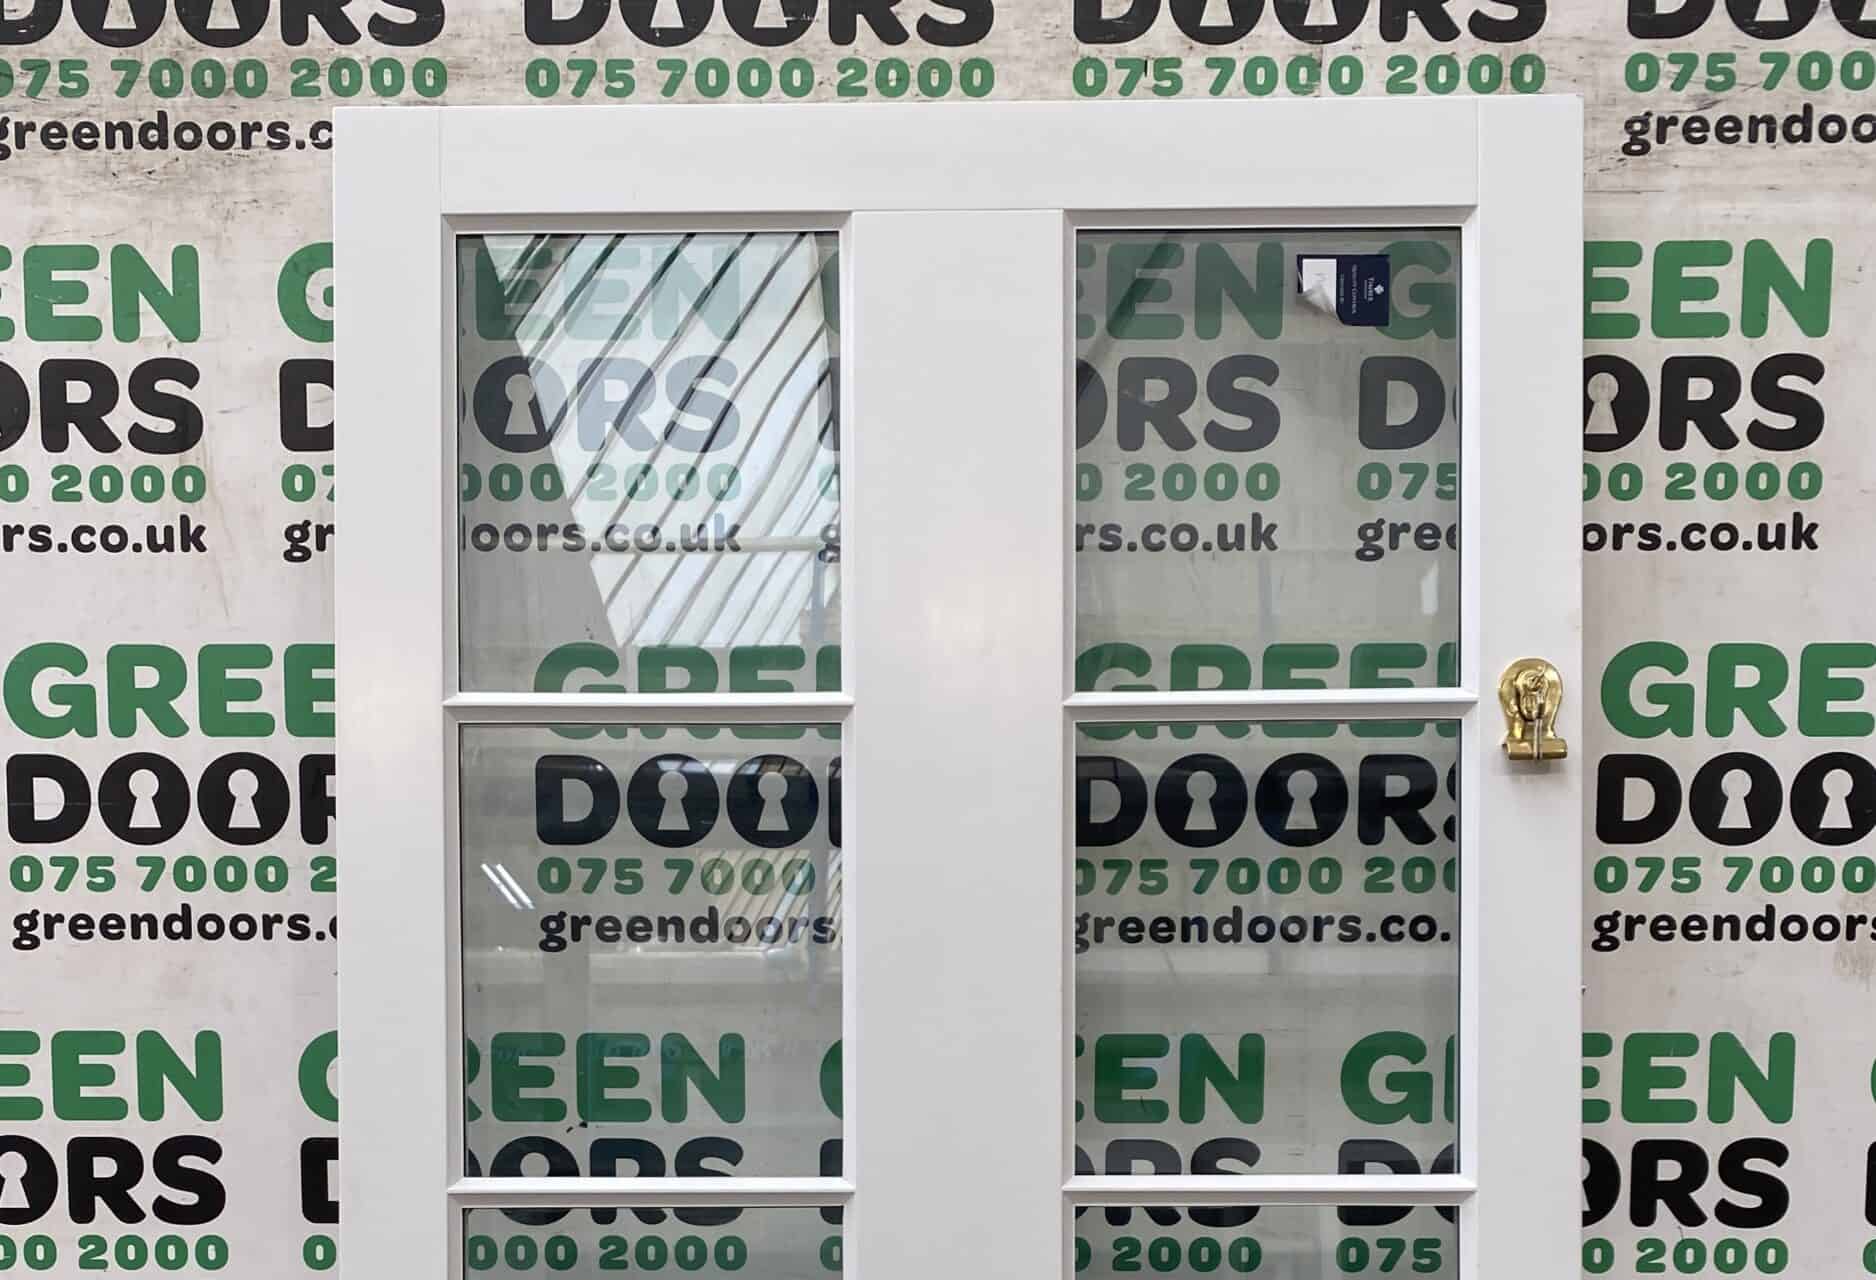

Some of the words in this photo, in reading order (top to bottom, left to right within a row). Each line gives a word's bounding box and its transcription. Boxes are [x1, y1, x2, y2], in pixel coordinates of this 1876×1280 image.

[110, 58, 268, 98] 7000
[290, 57, 448, 98] 2000
[525, 58, 635, 98] 075
[657, 58, 814, 98] 7000
[836, 57, 995, 97] 2000
[1072, 56, 1183, 97] 075
[1205, 55, 1364, 96] 7000
[1385, 54, 1546, 95] 2000
[1625, 52, 1737, 92] 075
[1759, 51, 1876, 91] 700
[0, 244, 203, 343] EN
[458, 244, 742, 342] EEN
[1076, 241, 1284, 340] EN
[458, 356, 742, 454] ORS
[1358, 356, 1457, 450] D
[51, 465, 206, 502] 2000
[586, 464, 743, 500] 2000
[1124, 463, 1281, 500] 2000
[1665, 463, 1823, 500] 2000
[461, 514, 742, 552] oors.co.uk
[534, 641, 842, 740] GRE
[1075, 641, 1457, 741] GREE
[1601, 641, 1876, 739] GRE
[535, 753, 842, 848] DOO
[1076, 752, 1457, 848] DOOR
[1595, 751, 1876, 846] DOO
[9, 855, 116, 892] 075
[135, 855, 288, 892] 7000
[537, 857, 644, 895] 075
[663, 857, 815, 895] 7000
[1189, 857, 1343, 895] 7000
[1594, 855, 1702, 893] 075
[1723, 855, 1876, 893] 7000
[12, 903, 336, 951] greendoors.
[538, 905, 842, 953] greendoors
[1591, 903, 1876, 952] greendoor
[467, 1032, 746, 1124] EEN
[1076, 1033, 1265, 1124] EN
[1341, 1031, 1455, 1125] G
[467, 1136, 744, 1226] ORS
[1076, 1137, 1261, 1227] RS
[1337, 1138, 1455, 1226] D
[78, 1234, 229, 1271] 2000
[599, 1235, 747, 1271] 2000
[1112, 1237, 1262, 1272] 2000
[1336, 1237, 1442, 1273] 075
[1635, 1238, 1789, 1274] 2000
